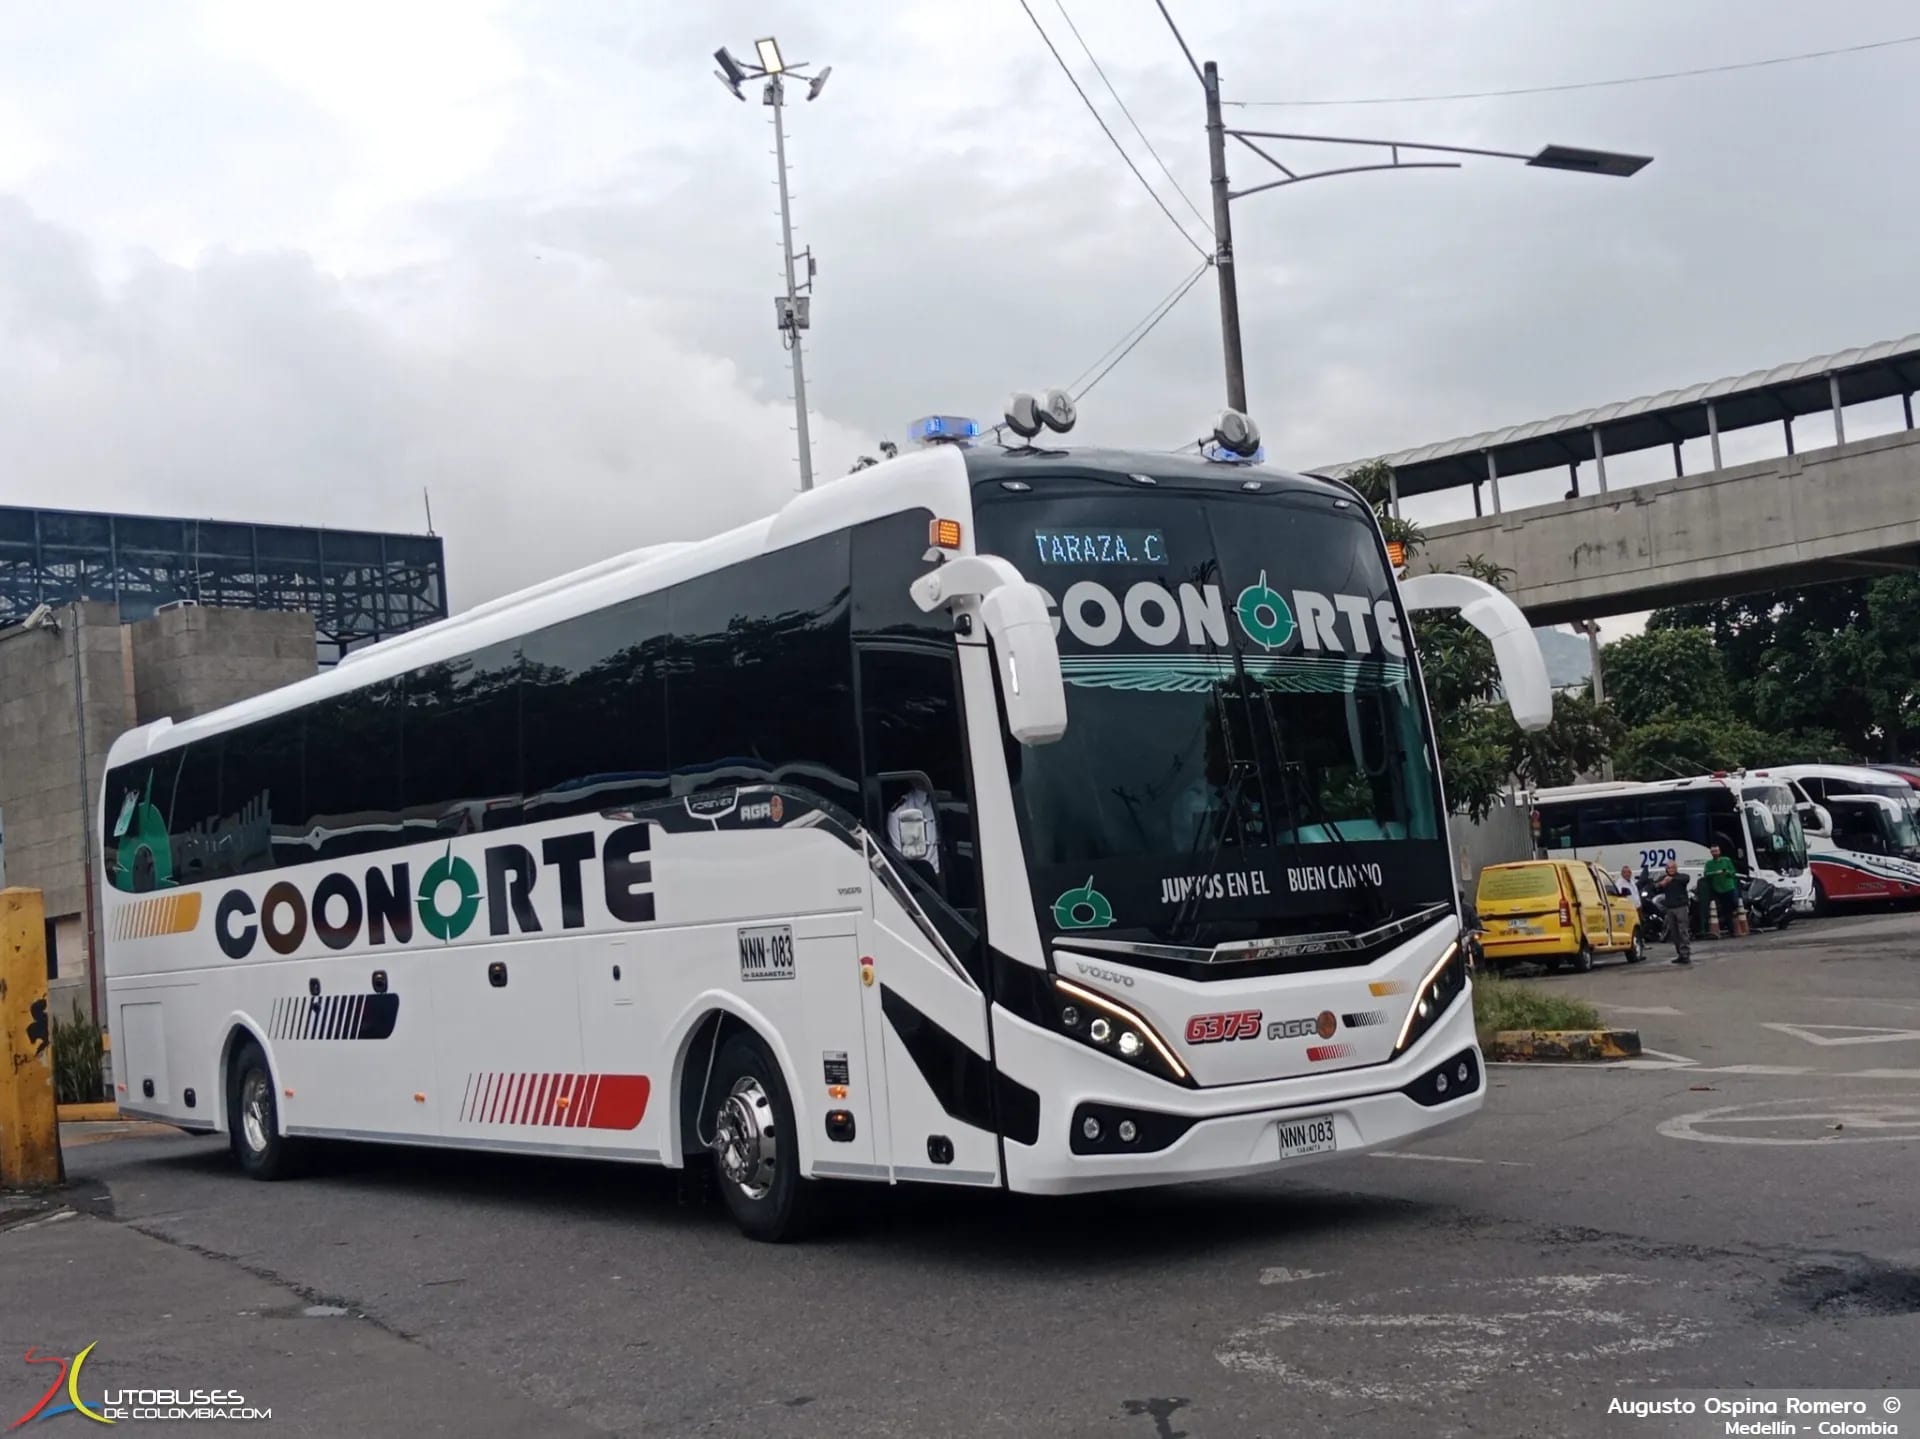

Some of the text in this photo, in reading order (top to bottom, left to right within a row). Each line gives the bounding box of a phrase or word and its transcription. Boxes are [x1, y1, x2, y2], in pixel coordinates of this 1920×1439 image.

[1640, 848, 1676, 868] 2929
[214, 821, 656, 960] COONORTE
[1226, 871, 1249, 897] EN
[1250, 870, 1271, 895] EL
[1287, 866, 1327, 892] BUEN
[1076, 962, 1134, 987] VOLVO
[1185, 1009, 1317, 1045] 6375 AGA
